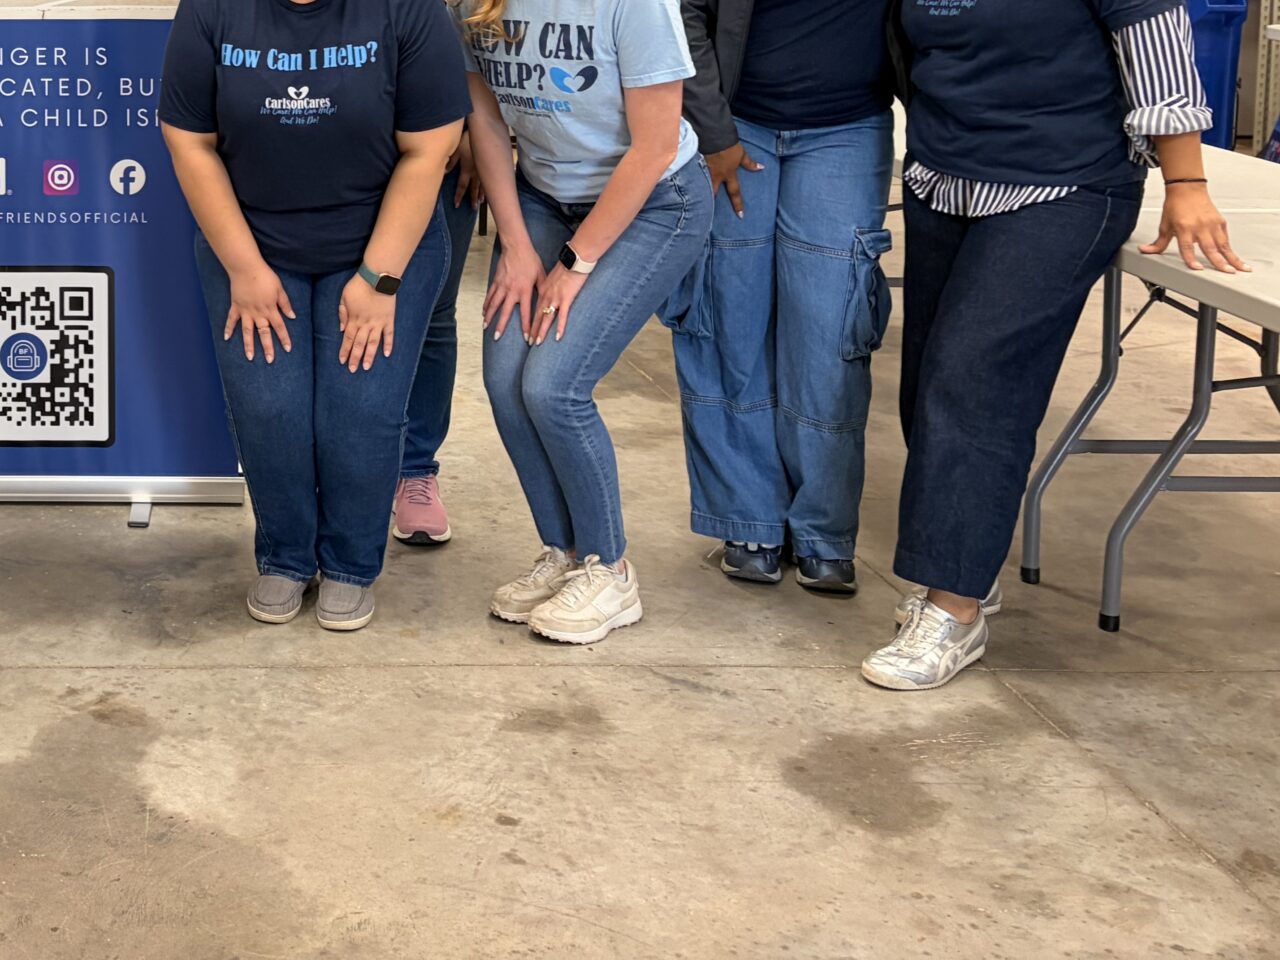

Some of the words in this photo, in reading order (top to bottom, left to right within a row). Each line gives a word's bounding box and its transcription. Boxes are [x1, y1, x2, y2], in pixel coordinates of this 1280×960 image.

[539, 22, 595, 60] CAN
[85, 47, 109, 66] IS
[221, 43, 261, 69] How
[267, 48, 303, 71] Can
[309, 49, 318, 70] I
[322, 41, 378, 68] Help?
[119, 78, 154, 96] BU
[265, 97, 331, 109] CarlsonCares
[493, 91, 572, 113] arlsonCares
[21, 108, 108, 127] CHILD
